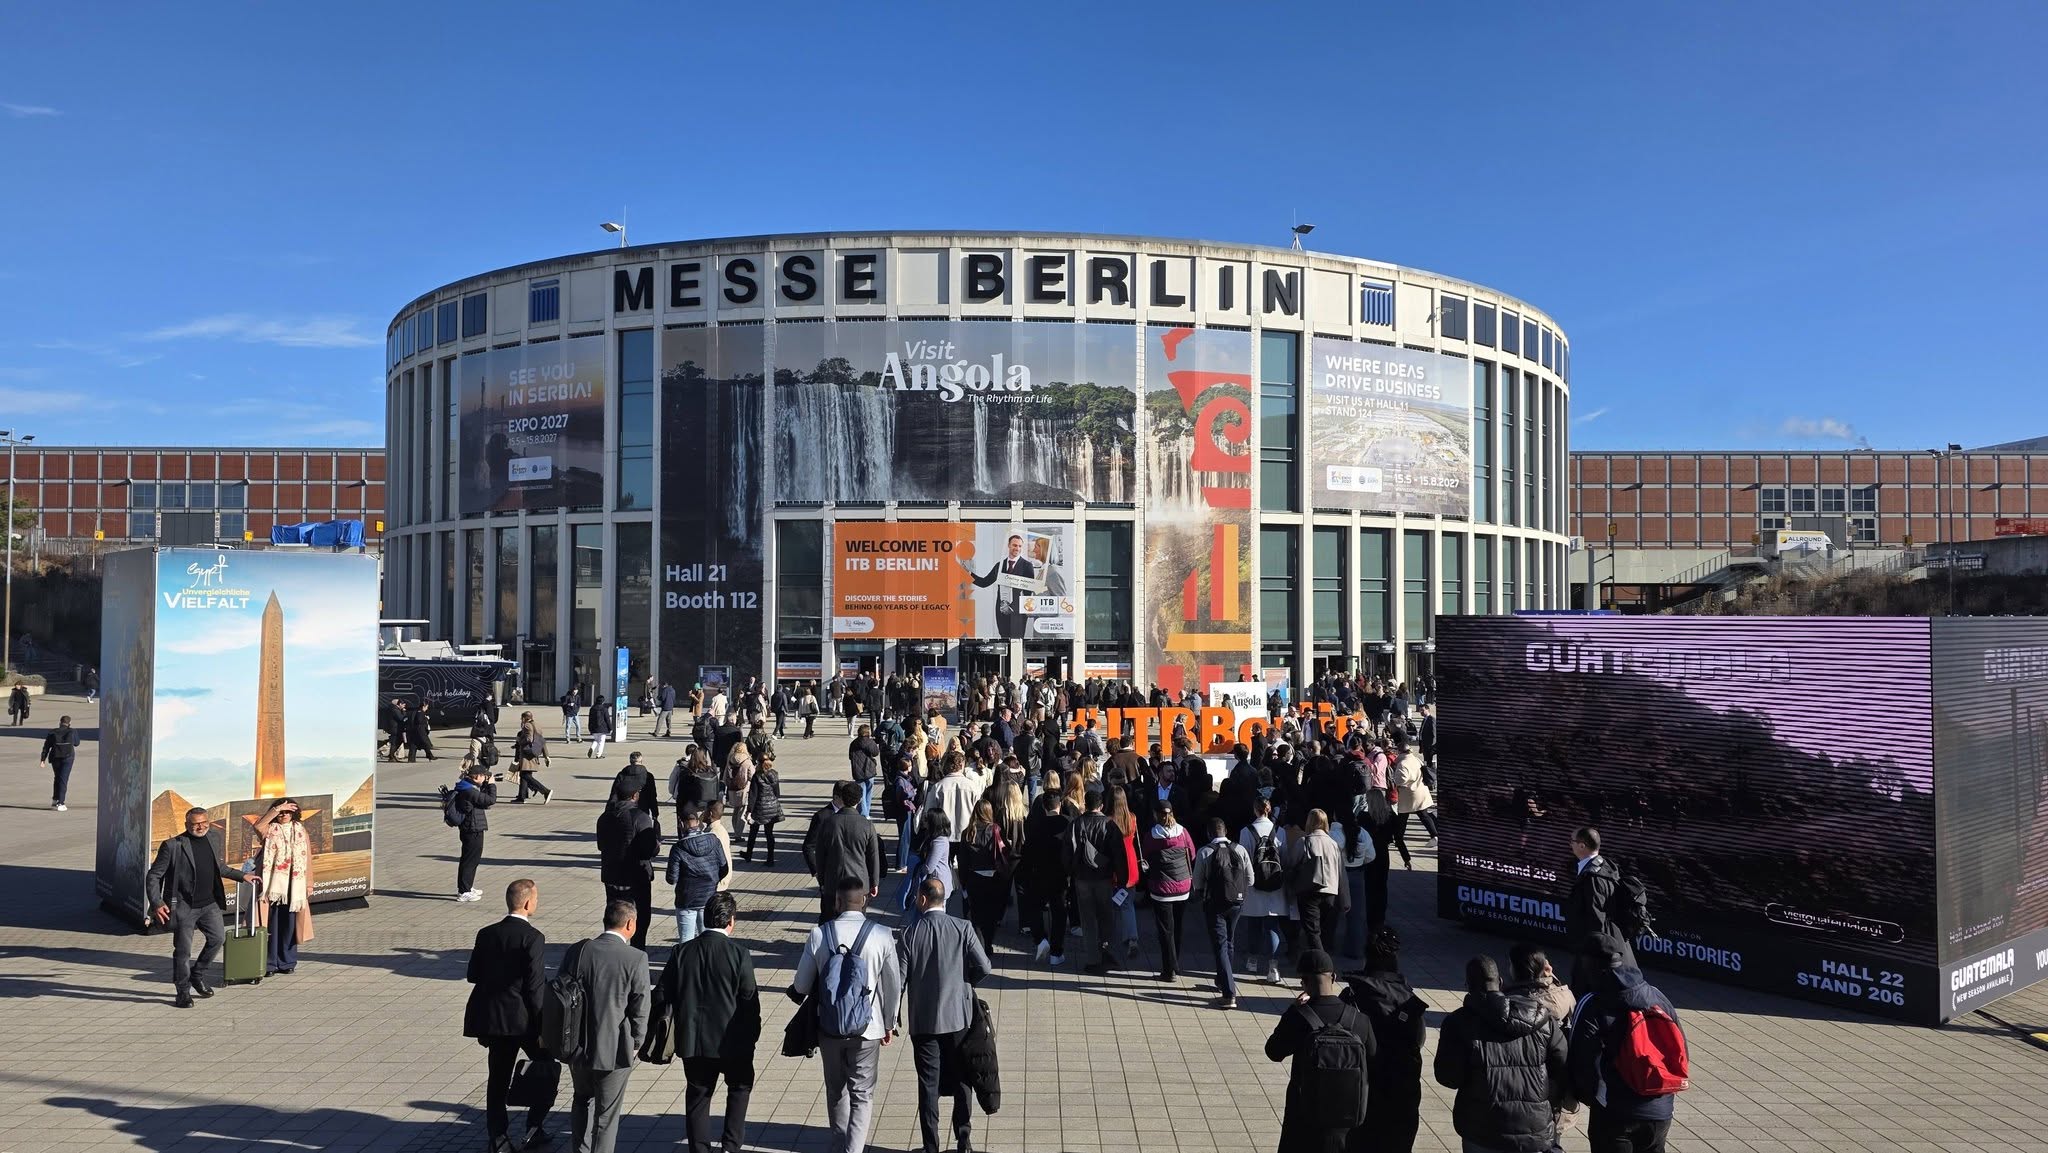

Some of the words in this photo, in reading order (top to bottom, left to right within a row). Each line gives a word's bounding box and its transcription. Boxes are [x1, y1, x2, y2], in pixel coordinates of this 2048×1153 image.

[614, 253, 877, 312] MESSE
[967, 253, 1305, 315] BERLIN
[905, 340, 955, 360] Visit
[509, 368, 536, 387] SEE
[541, 362, 575, 382] YOU
[1325, 354, 1381, 374] WHERE
[1385, 362, 1425, 380] IDEAS
[877, 352, 1032, 402] Angola
[509, 389, 523, 406] IN
[528, 381, 592, 404] SERBIA!
[1325, 373, 1372, 391] DRIVE
[1375, 379, 1441, 400] BUSINESS
[967, 394, 984, 403] The
[986, 394, 1022, 404] Rhythm
[1024, 394, 1035, 403] of
[1036, 394, 1053, 404] Life
[1326, 394, 1350, 406] VISIT
[1351, 396, 1363, 407] US
[1364, 398, 1374, 408] AT
[1374, 399, 1398, 411] HALL
[1326, 406, 1356, 418] STAND
[1358, 408, 1372, 419] 124
[508, 417, 538, 433] EXPO
[541, 414, 569, 430] 2027
[526, 433, 557, 445] 15.8.2027
[1394, 473, 1412, 484] 15.5
[1420, 475, 1460, 488] 15.8.2027
[845, 540, 927, 553] WELCOME
[931, 540, 953, 553] TO
[666, 563, 703, 582] Hall
[708, 564, 727, 582] 21
[845, 557, 869, 571] ITB
[875, 557, 939, 571] BERLIN!
[182, 588, 250, 596] Unvergleichliche
[665, 590, 725, 609] Booth
[730, 592, 757, 609] 112
[845, 603, 872, 611] BEHIND
[873, 603, 883, 611] 60
[885, 603, 908, 611] YEARS
[910, 603, 919, 611] OF
[921, 603, 951, 611] LEGACY.
[1040, 598, 1054, 606] ITB
[444, 688, 471, 699] holiday
[1232, 694, 1262, 709] Angola
[1456, 854, 1477, 867] Hall
[1480, 859, 1495, 871] 22
[312, 883, 367, 896] perienceegypt.eg
[313, 876, 367, 888] ExperienceEgypt
[1457, 885, 1567, 922] GUATEMAL
[1488, 912, 1520, 924] SEASON
[1636, 934, 1673, 955] YOUR
[1676, 941, 1742, 972] STORIES
[1822, 959, 1874, 982] HALL
[1879, 970, 1905, 988] 22
[1951, 948, 2014, 991] GUATEMALA
[1797, 972, 1862, 997] STAND
[1867, 986, 1905, 1006] 206
[1967, 984, 1986, 999] SEASON
